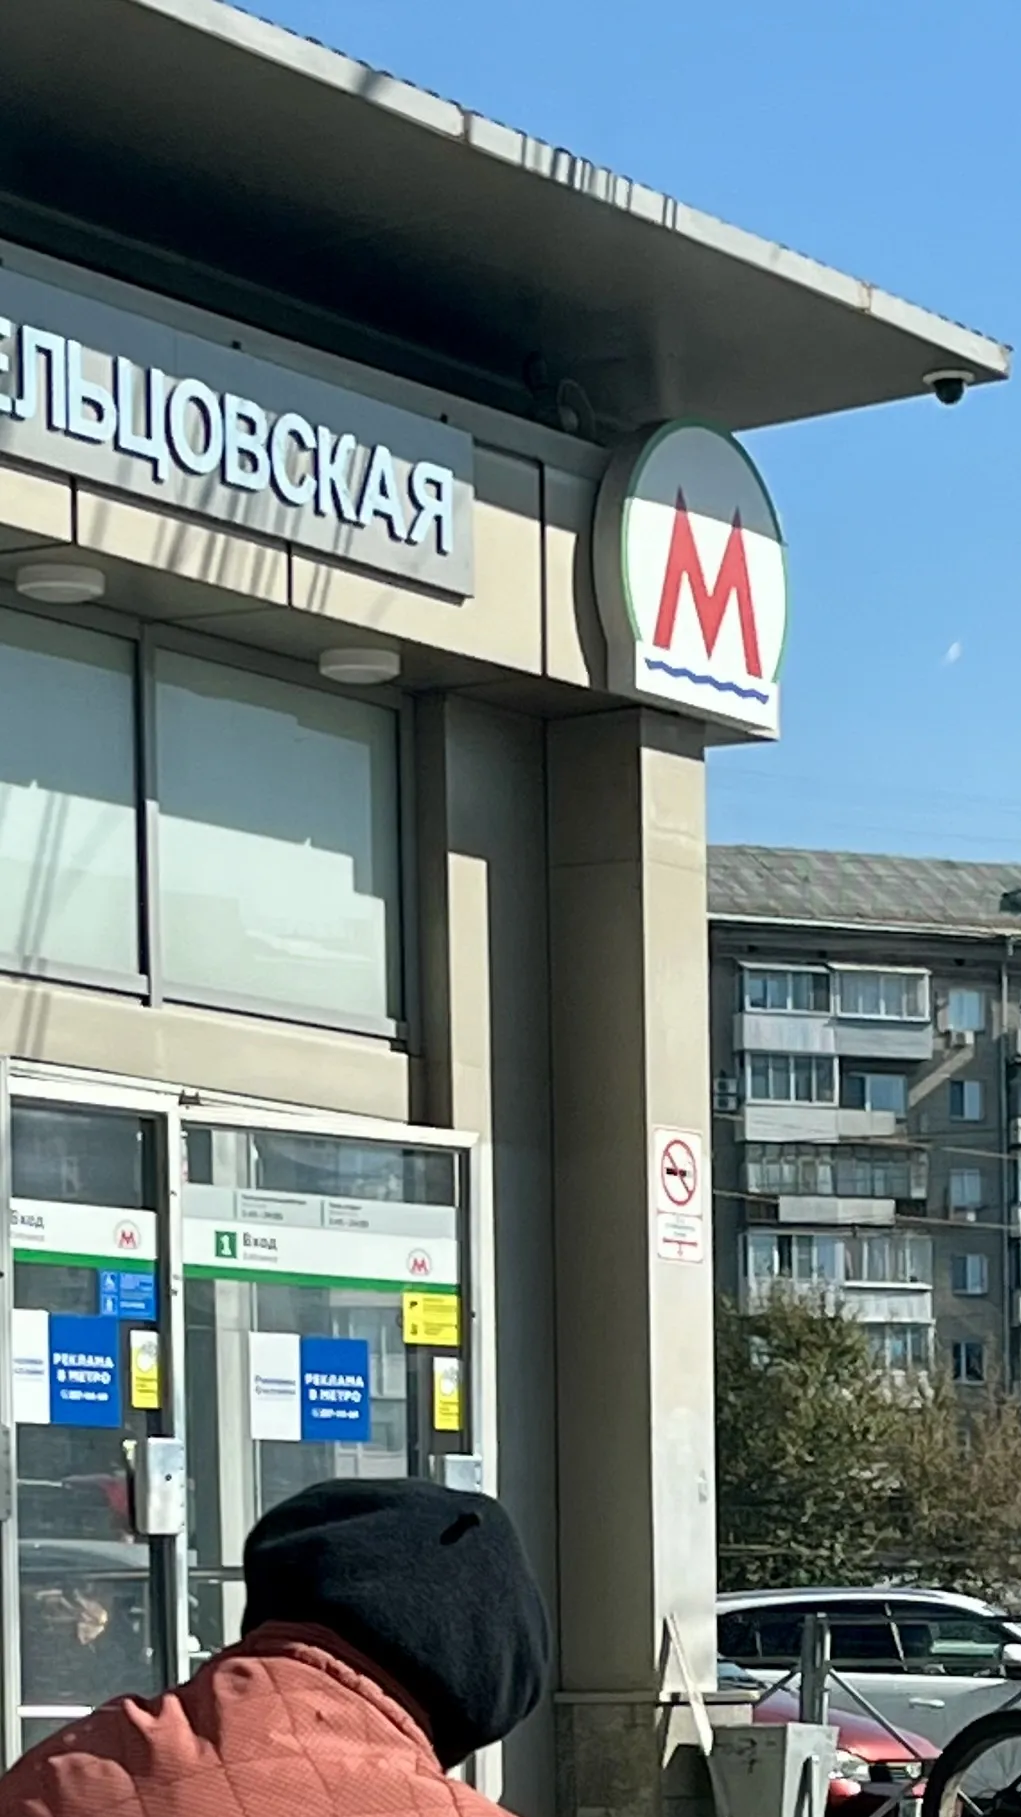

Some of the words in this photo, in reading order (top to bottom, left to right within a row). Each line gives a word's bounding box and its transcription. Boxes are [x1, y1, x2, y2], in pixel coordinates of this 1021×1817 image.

[653, 484, 762, 679] М
[242, 1231, 278, 1251] Вход
[52, 1352, 115, 1369] РЕКЛАМА
[56, 1369, 67, 1383] В
[68, 1369, 112, 1385] МЕТРО
[304, 1373, 365, 1389] РЕКЛАМА
[308, 1388, 318, 1401] В
[319, 1388, 362, 1403] МЕТРО
